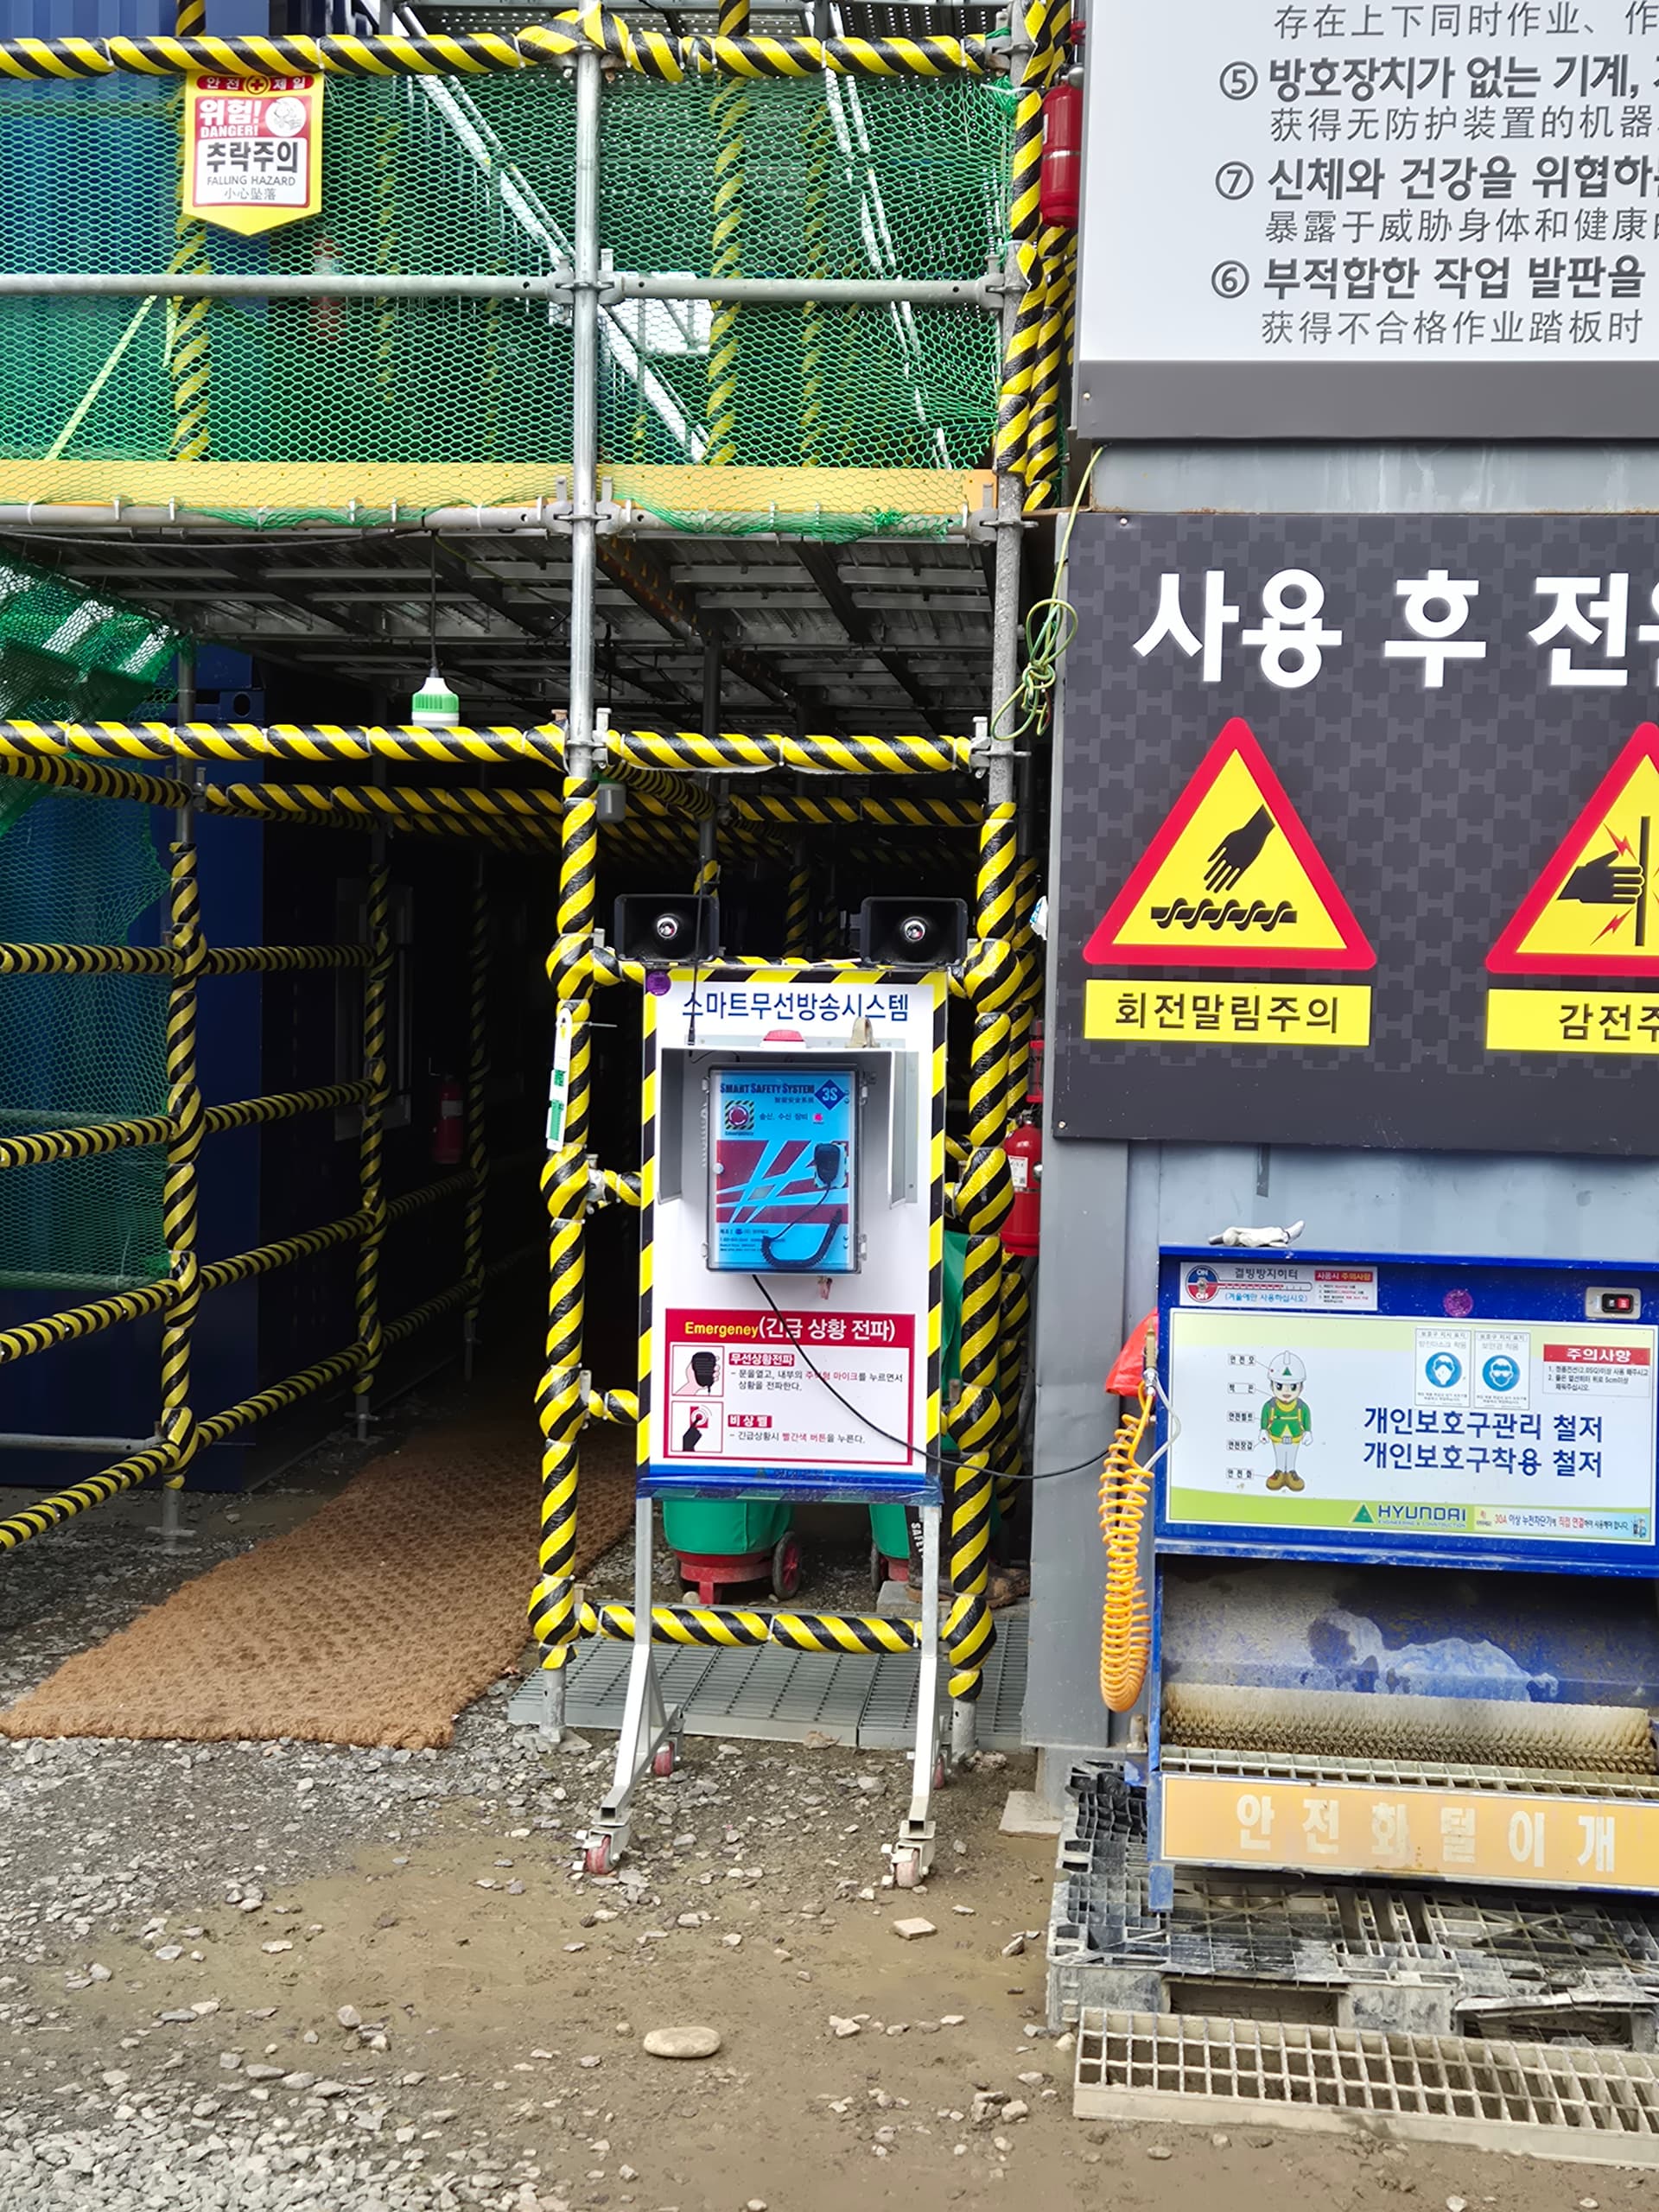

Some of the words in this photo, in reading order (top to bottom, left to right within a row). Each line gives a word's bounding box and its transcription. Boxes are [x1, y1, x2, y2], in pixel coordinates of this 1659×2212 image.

[207, 77, 239, 90] 안전
[273, 77, 305, 90] 제일
[1268, 57, 1456, 101] 방호장치가
[1466, 56, 1541, 98] 없는
[1554, 54, 1639, 99] 기계,
[200, 99, 262, 126] 위험!
[1270, 105, 1652, 142] 获得无防护装置的机器
[200, 125, 258, 138] DANGER!
[207, 141, 298, 173] 추락주의
[207, 176, 247, 185] FALLING
[251, 176, 296, 186] HAZARD
[1267, 157, 1385, 200] 신체와
[1399, 156, 1517, 200] 건강을
[1532, 155, 1659, 199] 위협하
[1265, 207, 1659, 244] 暴露于威胁身体和健康
[1263, 257, 1420, 301] 부적합한
[1433, 257, 1510, 300] 작업
[1529, 255, 1646, 299] 발판을
[1262, 309, 1643, 345] 获得不合格作业踏板时
[1133, 568, 1343, 688] 사용
[1384, 569, 1486, 688] 후
[1529, 572, 1659, 686] 전
[683, 991, 909, 1022] 스마트무선방송시스템
[1115, 991, 1338, 1034] 회전말림주의
[720, 1083, 749, 1093] SMART
[751, 1083, 780, 1094] SAFETY
[783, 1083, 815, 1094] SYSTEM
[822, 1087, 838, 1101] 3S
[808, 1318, 847, 1340] 상황
[851, 1319, 896, 1342] 전파)
[731, 1353, 792, 1365] 무선상황전파
[1567, 1348, 1631, 1363] 주의사항
[738, 1431, 779, 1441] 긴급상황시
[1363, 1408, 1541, 1440] 개인보호구관리
[1554, 1414, 1602, 1443] 철저
[1363, 1442, 1541, 1477] 개인보호구착용
[1553, 1449, 1601, 1478] 철저
[1378, 1504, 1466, 1521] HYUNDAI
[1236, 1793, 1616, 1873] 안전화털이개
